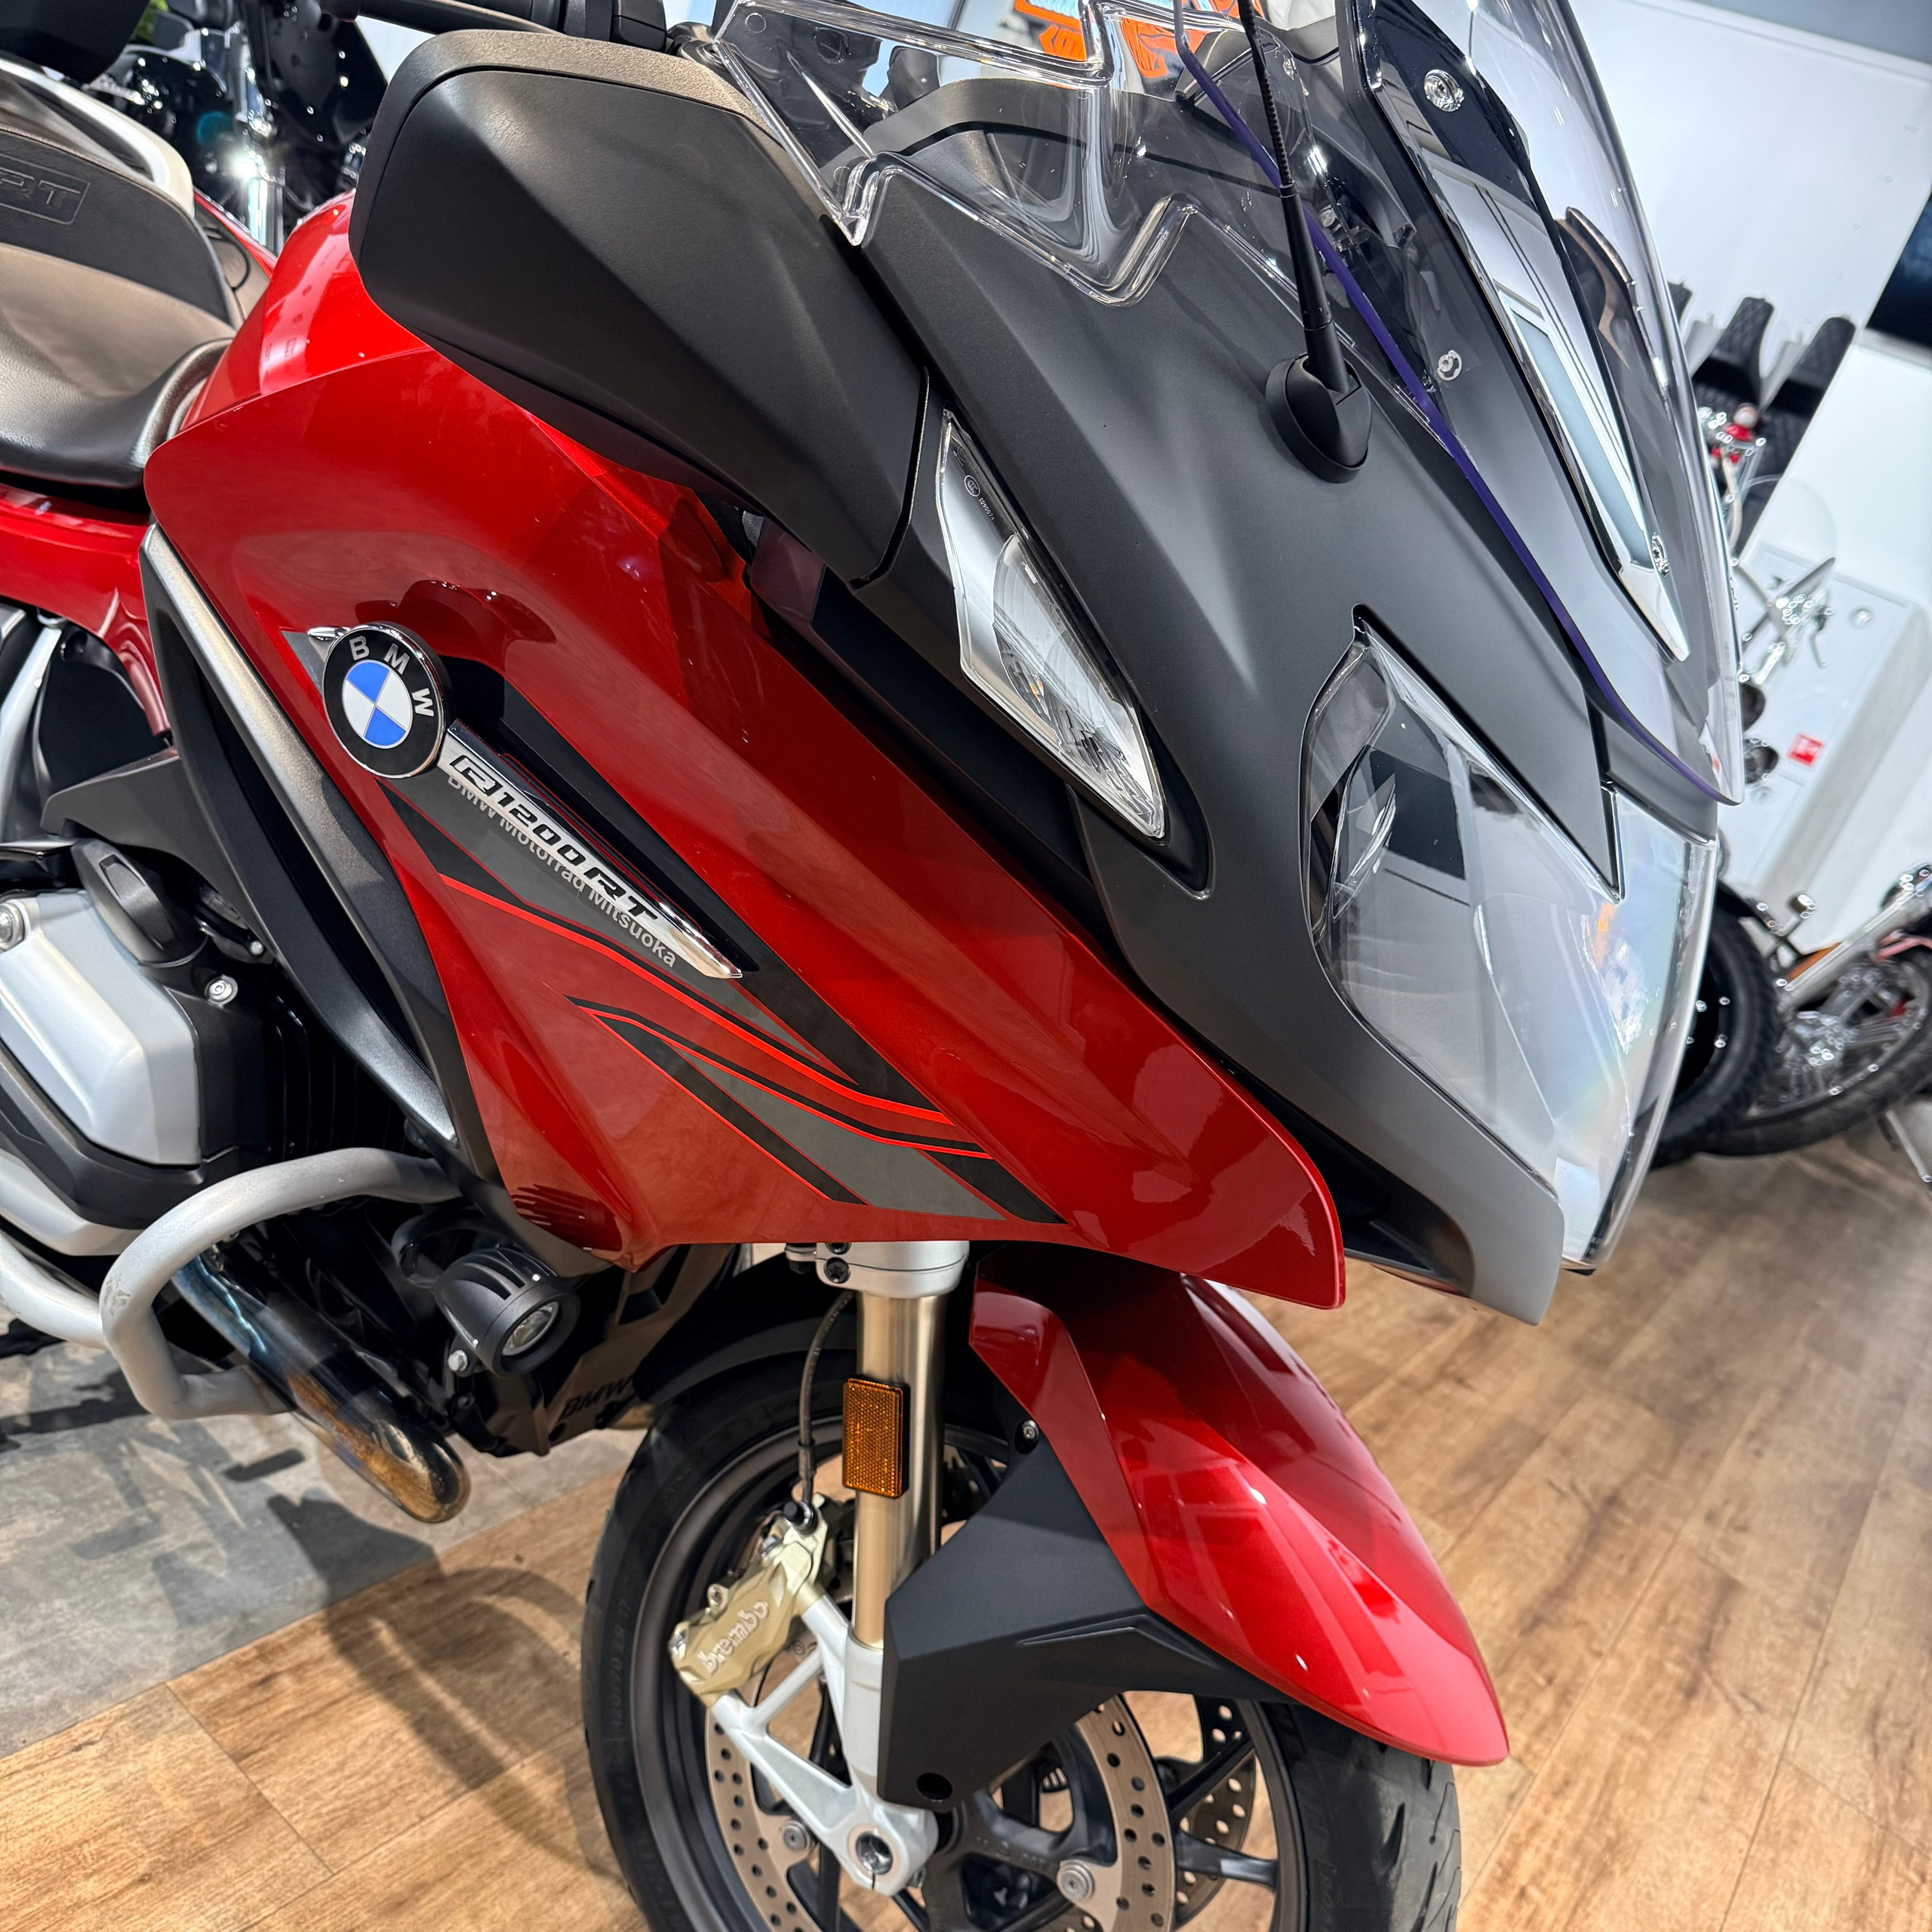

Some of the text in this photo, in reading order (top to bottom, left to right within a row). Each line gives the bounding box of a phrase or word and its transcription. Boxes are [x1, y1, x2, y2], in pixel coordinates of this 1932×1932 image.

[349, 635, 434, 717] BMW
[589, 891, 676, 968] Mitsuoka
[562, 1377, 633, 1417] BMW
[697, 1601, 768, 1675] brembo
